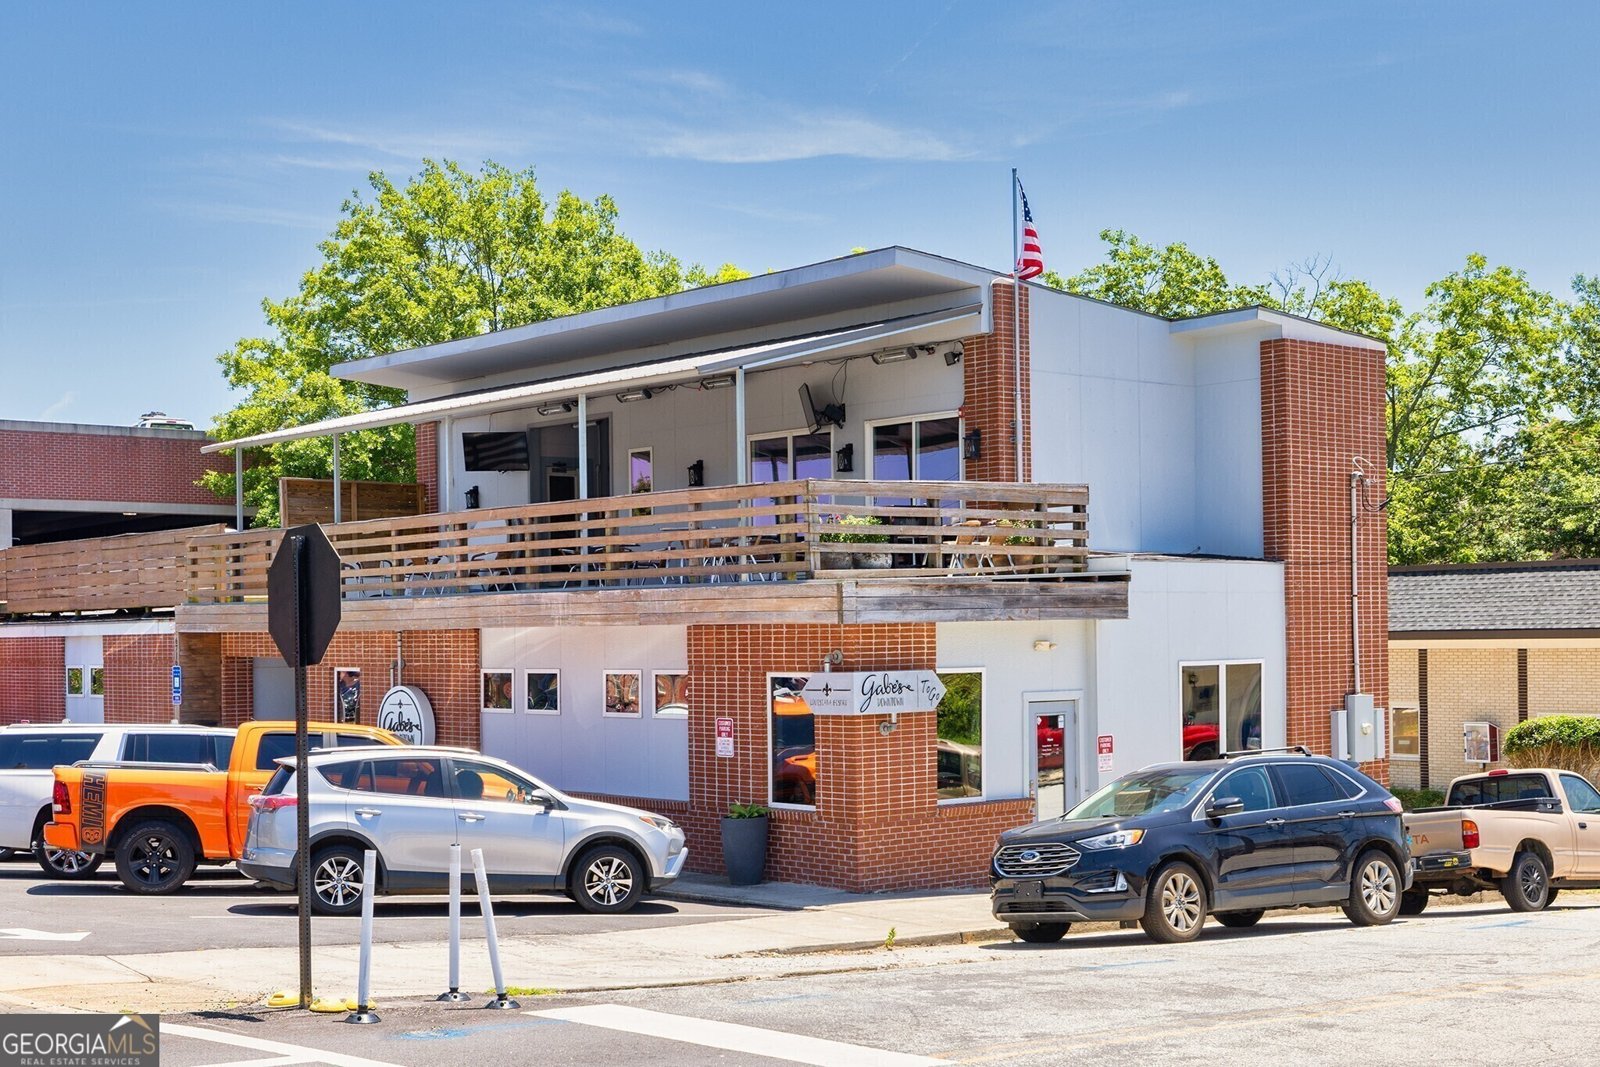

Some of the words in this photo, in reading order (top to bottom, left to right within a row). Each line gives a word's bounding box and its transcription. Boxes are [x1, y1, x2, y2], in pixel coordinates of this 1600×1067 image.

[860, 673, 914, 713] Gabe's
[920, 679, 930, 693] To
[82, 773, 105, 828] HEMI
